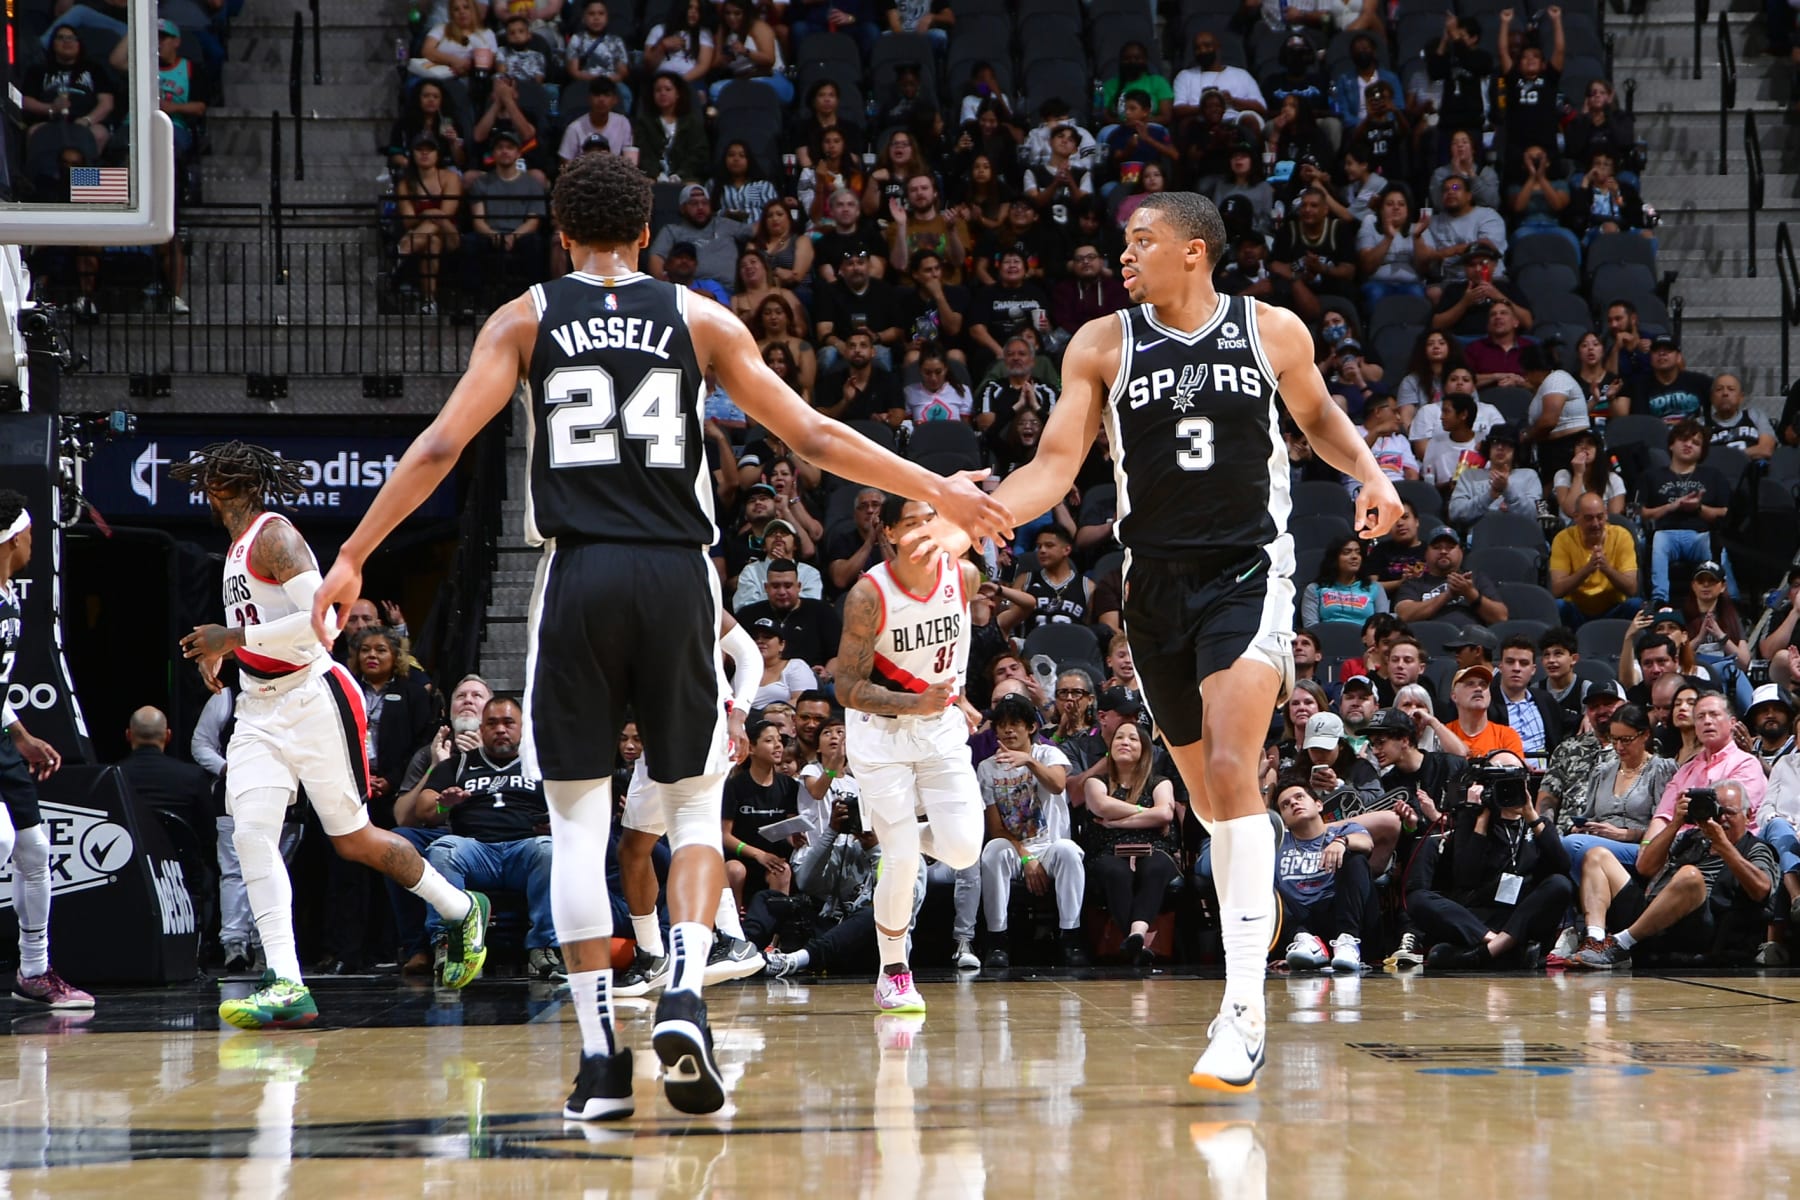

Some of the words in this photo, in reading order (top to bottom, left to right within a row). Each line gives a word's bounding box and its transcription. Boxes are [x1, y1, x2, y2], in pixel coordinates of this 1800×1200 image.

[550, 316, 674, 361] VASSELL
[1217, 337, 1249, 351] Frost
[1128, 363, 1262, 413] SPURS
[543, 365, 687, 469] 24
[1176, 417, 1215, 471] 3
[1036, 596, 1084, 618] PURS
[891, 613, 961, 653] BLAZERS
[932, 642, 957, 674] 35
[464, 775, 537, 794] SPURS
[493, 792, 506, 808] 1
